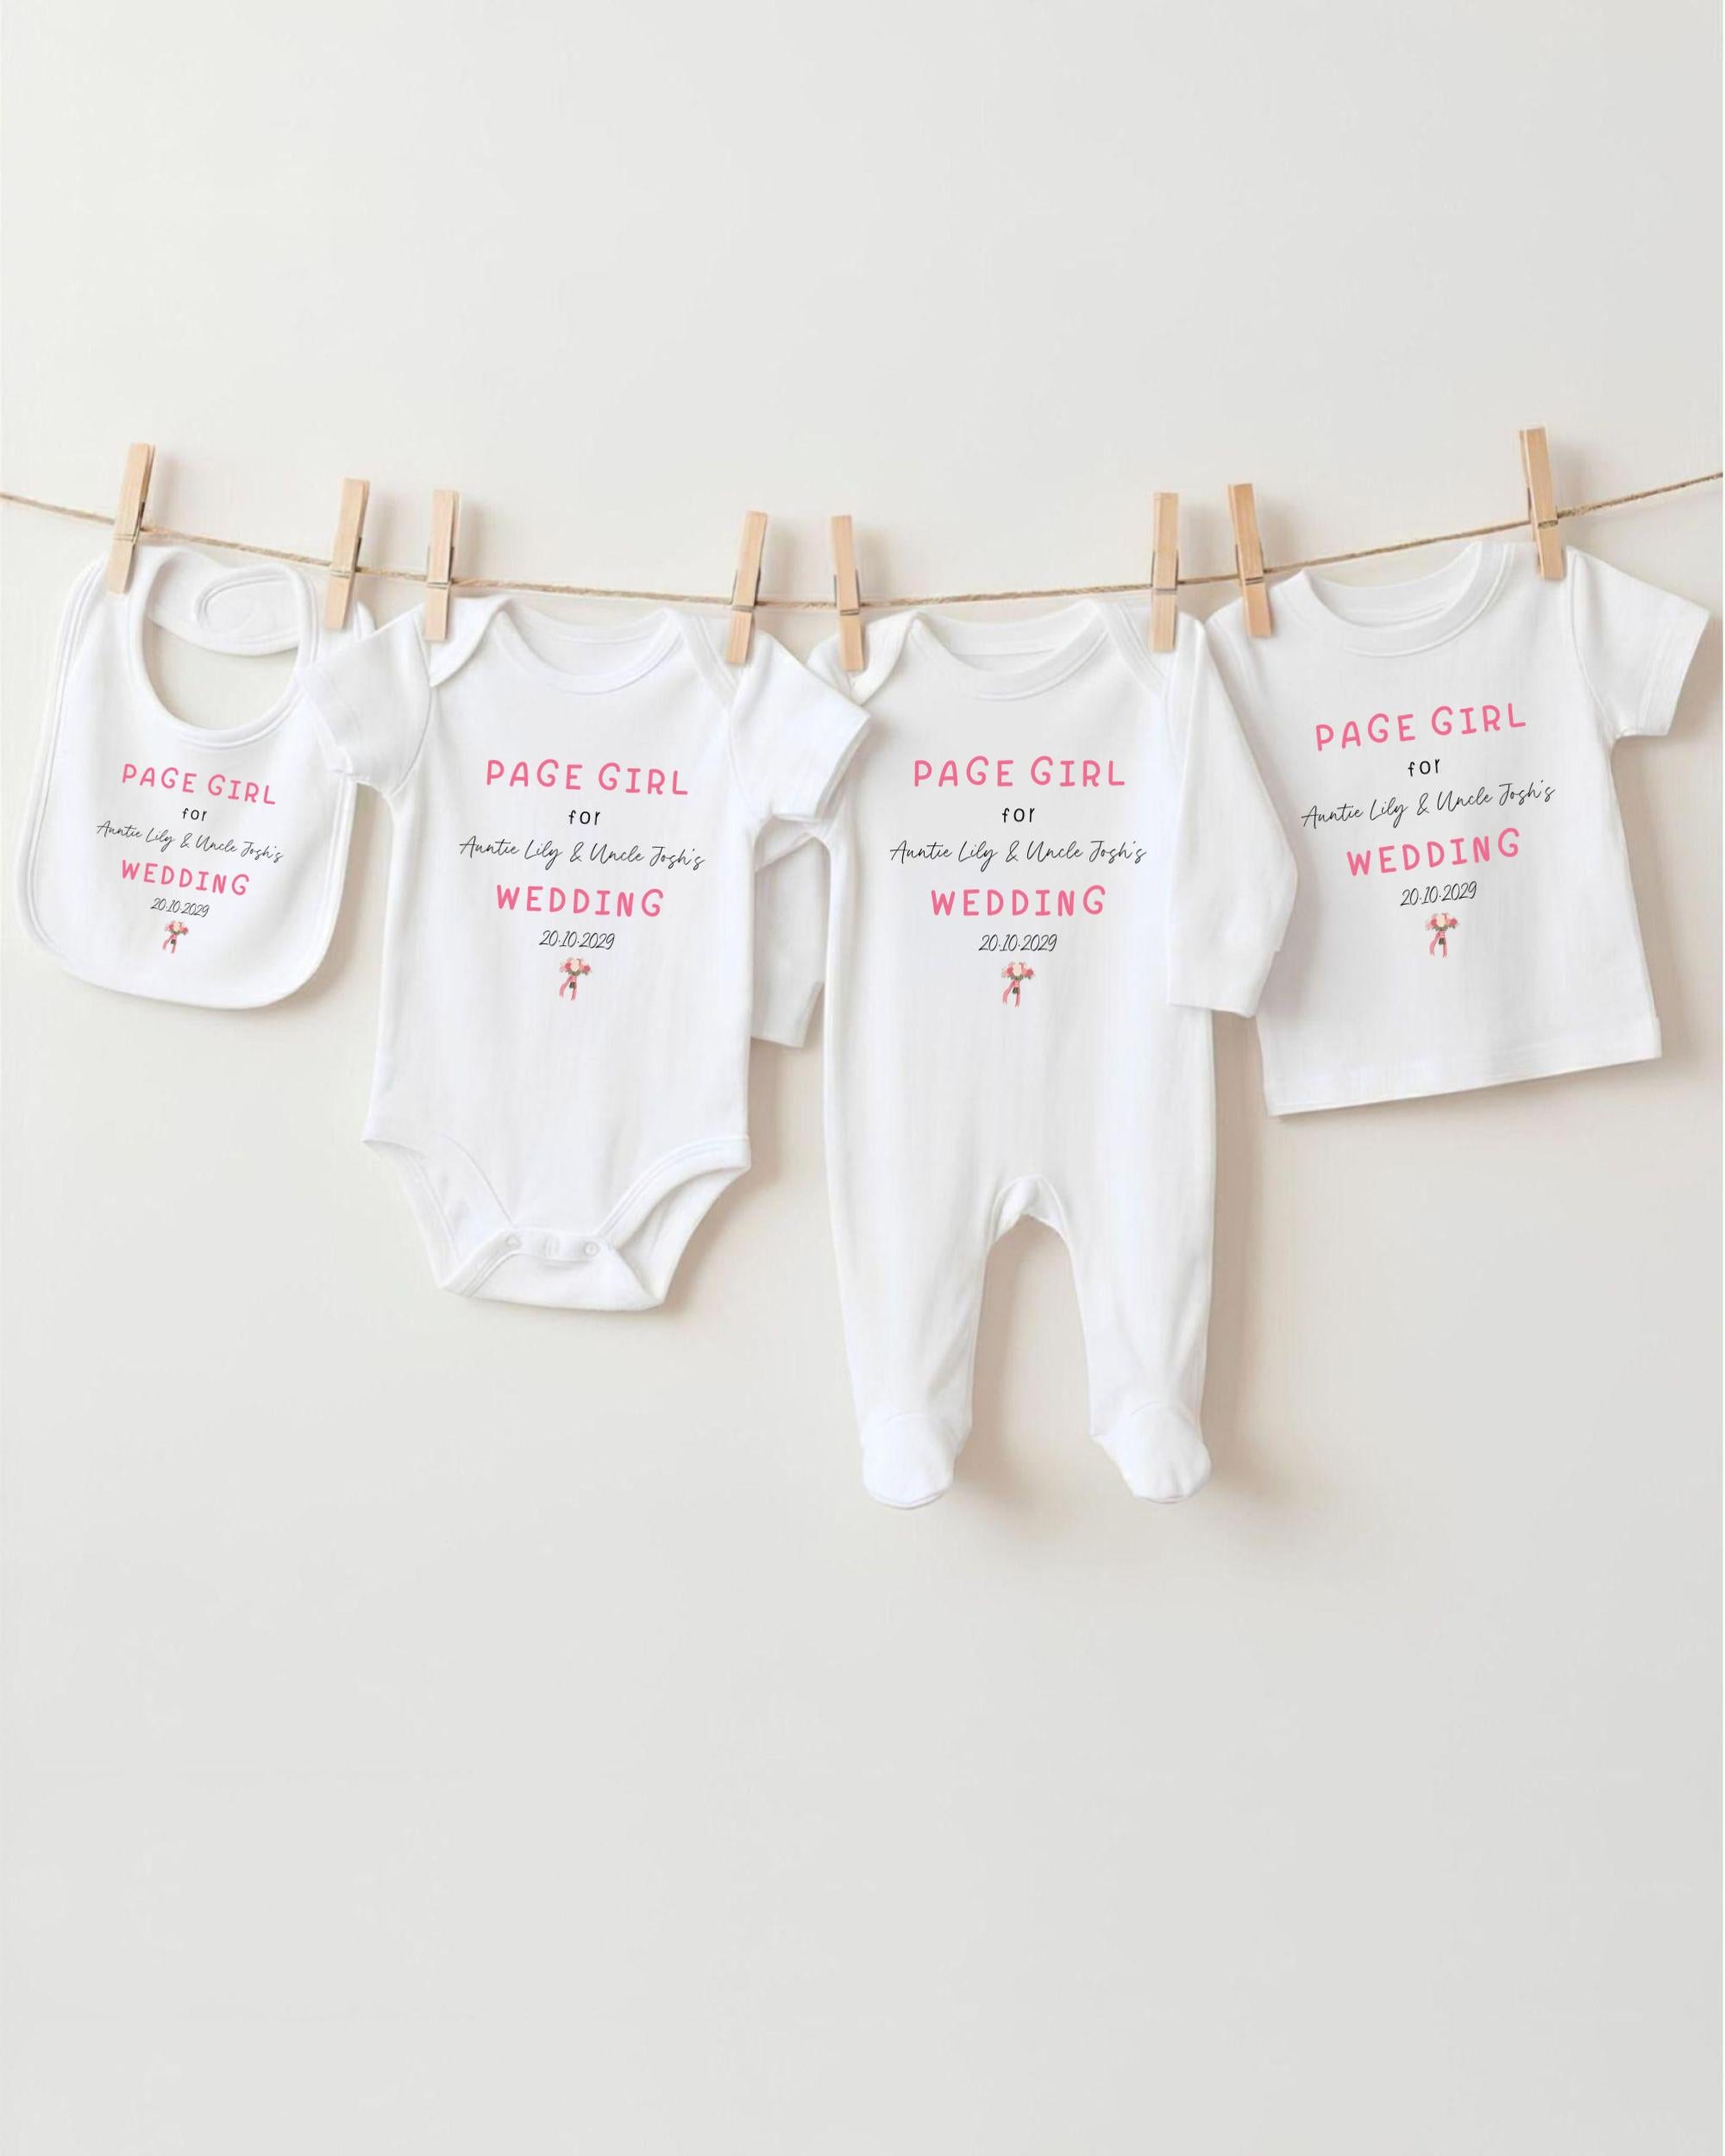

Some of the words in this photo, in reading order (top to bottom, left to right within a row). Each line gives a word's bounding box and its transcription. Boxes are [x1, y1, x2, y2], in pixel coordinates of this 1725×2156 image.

[1315, 713, 1416, 752] PAGE
[1431, 703, 1527, 736] GIRL
[122, 763, 197, 793] PAGE
[208, 774, 276, 805] GIRL
[486, 759, 583, 790] PAGE
[598, 762, 688, 795] GIRL
[914, 755, 1013, 787] PAGE
[1031, 755, 1125, 787] GIRL
[1408, 759, 1440, 777] for
[182, 808, 207, 821] for
[568, 810, 600, 825] for
[1001, 807, 1035, 823] for
[1302, 803, 1364, 829] Auntie
[1370, 797, 1408, 828] Lily
[1416, 793, 1430, 816] &
[1437, 787, 1493, 812] Uncle
[1499, 780, 1555, 805] Josh's
[97, 820, 142, 839] Auntie
[146, 828, 176, 852] Lily
[179, 833, 191, 848] &
[196, 835, 238, 853] Uncle
[241, 842, 283, 863] Josh's
[459, 836, 520, 859] Auntie
[524, 839, 563, 870] Lily
[569, 842, 584, 862] &
[590, 843, 644, 864] Uncle
[649, 845, 706, 871] Josh's
[890, 840, 952, 864] Auntie
[958, 840, 998, 873] Lily
[1006, 840, 1019, 862] &
[1027, 840, 1083, 862] Uncle
[1089, 840, 1147, 864] Josh's
[1346, 828, 1520, 876] WEDDING
[122, 859, 249, 896] WEDDING
[1400, 881, 1477, 906] 20.10.2029
[150, 898, 210, 918] 20.10.2029
[497, 884, 663, 917] WEDDING
[932, 885, 1106, 916] WEDDING
[539, 930, 615, 950] 20.10.2029
[978, 934, 1057, 952] 20.10.2029
